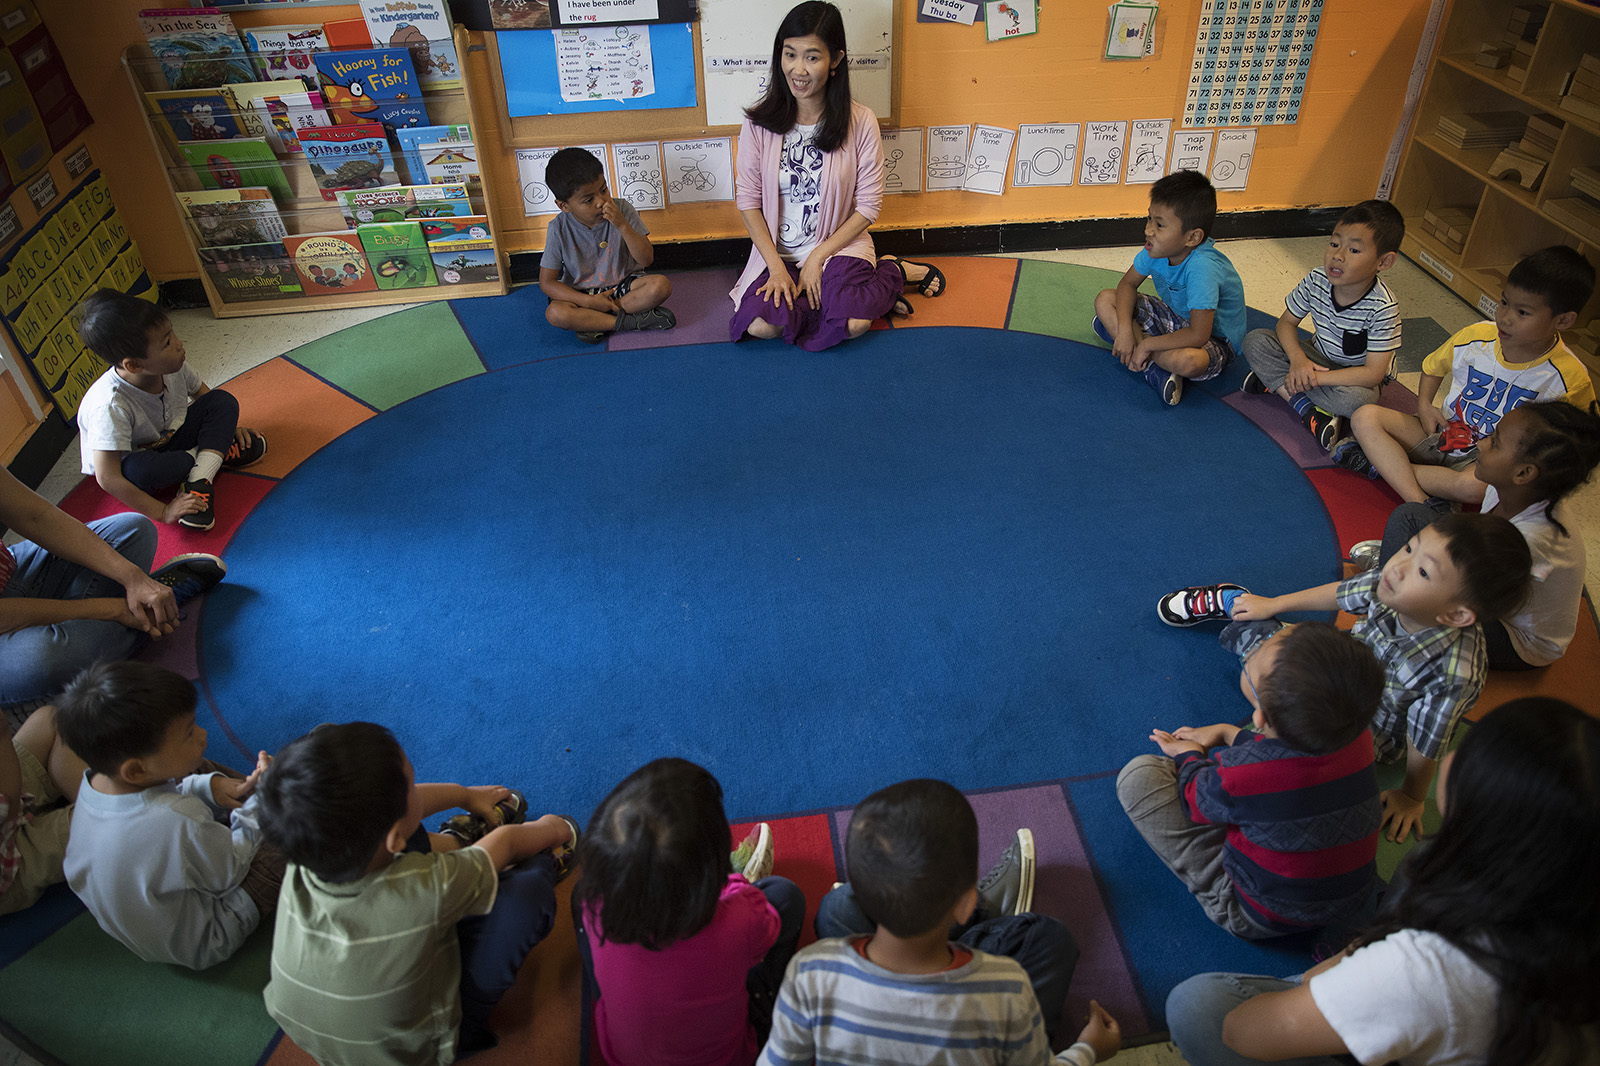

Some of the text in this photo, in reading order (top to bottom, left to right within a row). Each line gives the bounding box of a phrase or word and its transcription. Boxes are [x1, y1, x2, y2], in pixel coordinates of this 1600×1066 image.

[385, 1, 417, 12] Buffalo
[934, 0, 964, 11] uesday
[1217, 2, 1224, 10] 12
[1230, 2, 1237, 10] 13
[1254, 1, 1261, 9] 15
[1266, 0, 1273, 9] 16
[1290, 0, 1298, 8] 18
[380, 11, 440, 22] Kindergarten?
[930, 7, 946, 16] Thu
[1213, 17, 1223, 25] 22
[1238, 16, 1247, 24] 24
[1250, 16, 1259, 24] 25
[1262, 16, 1272, 24] 26
[1286, 15, 1296, 23] 28
[1298, 15, 1308, 23] 29
[1309, 14, 1320, 23] 30
[158, 20, 217, 32] In the Sea
[1005, 27, 1020, 35] hot
[1199, 32, 1207, 40] 31
[1210, 32, 1220, 40] 32
[1234, 31, 1244, 39] 34
[1247, 31, 1256, 39] 35
[1258, 30, 1268, 38] 36
[1282, 30, 1293, 38] 38
[1294, 30, 1304, 38] 39
[1306, 29, 1316, 37] 40
[260, 40, 286, 49] Things
[1280, 44, 1290, 52] 48
[1302, 44, 1313, 52] 50
[332, 54, 403, 77] Hooray for
[1205, 61, 1215, 69] 52
[1241, 60, 1250, 68] 55
[1276, 59, 1286, 67] 58
[1299, 58, 1310, 66] 60
[367, 70, 408, 92] Fish!
[383, 109, 400, 120] Lucy
[1091, 123, 1119, 132] Work
[980, 130, 1002, 140] Recall
[1093, 132, 1117, 141] Time
[1188, 136, 1205, 144] nap
[1221, 133, 1247, 141] Snack
[308, 140, 383, 157] Dinosaurs
[354, 195, 406, 207] TOOLS
[373, 234, 410, 245] Bugs
[228, 275, 284, 289] Whose Shoes?
